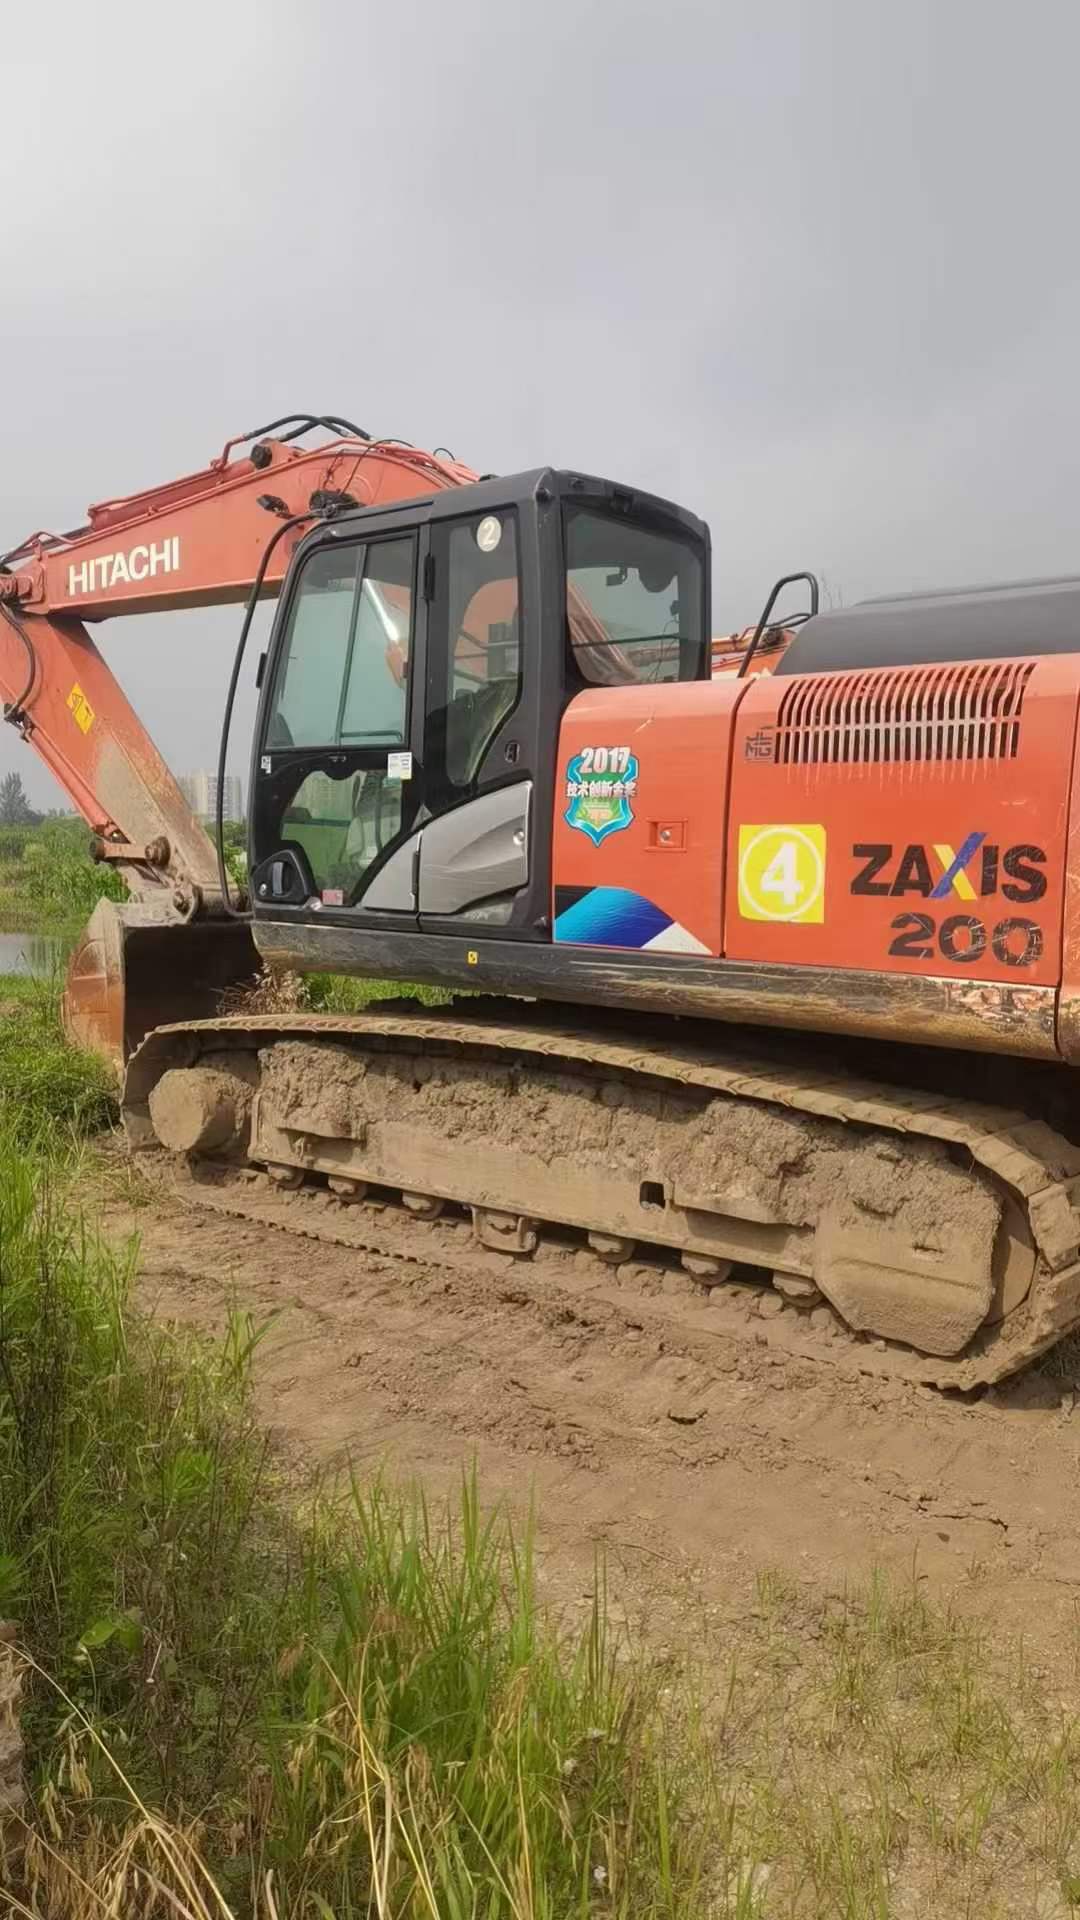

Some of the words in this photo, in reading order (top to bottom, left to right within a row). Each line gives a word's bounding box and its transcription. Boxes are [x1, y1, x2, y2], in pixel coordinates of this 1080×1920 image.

[68, 535, 180, 597] HITACHI
[579, 747, 631, 774] 2017
[760, 841, 804, 906] 4
[850, 832, 1048, 903] ZAXIS
[887, 912, 1044, 967] 200
